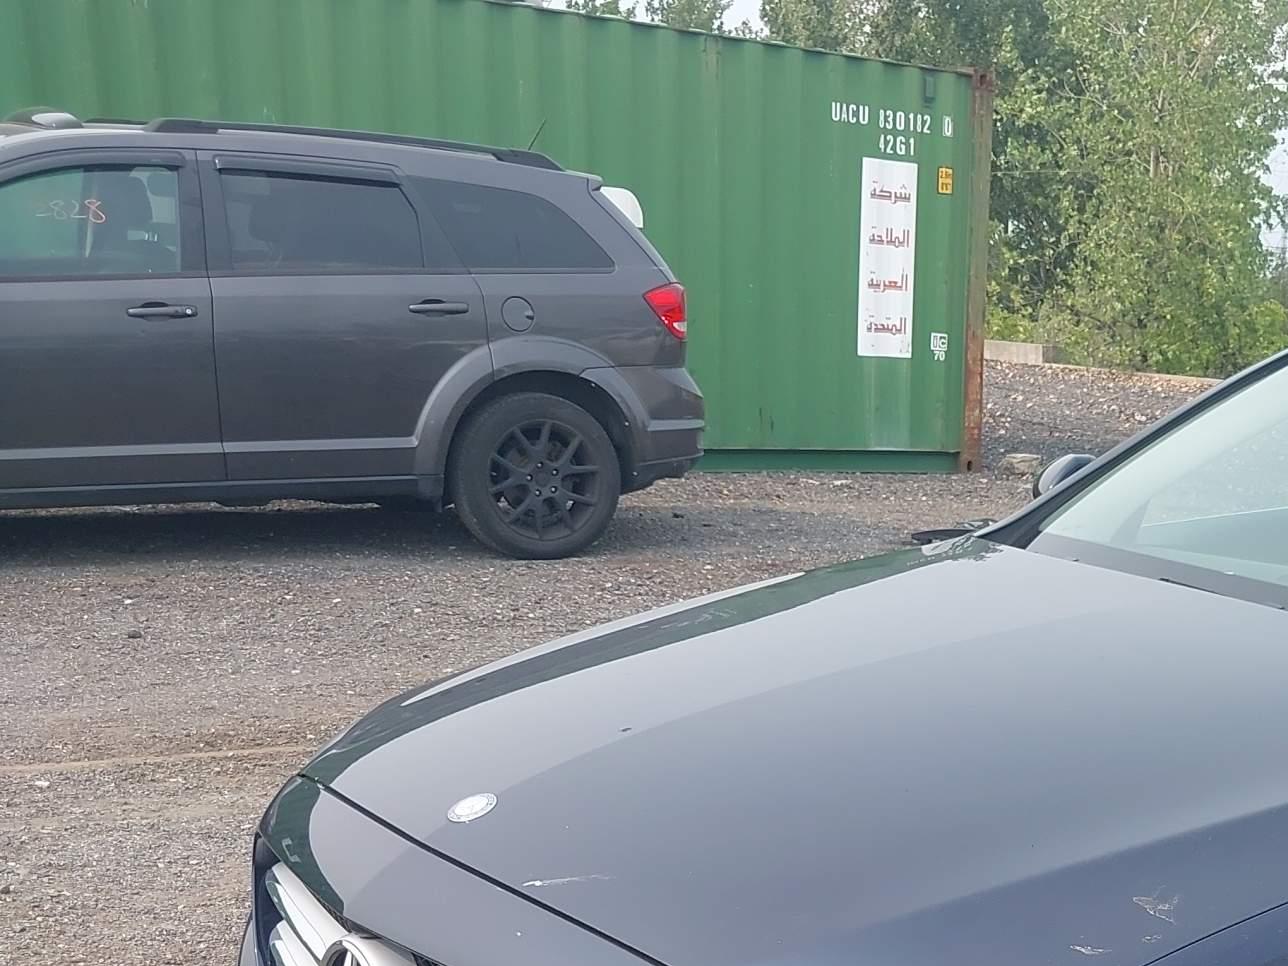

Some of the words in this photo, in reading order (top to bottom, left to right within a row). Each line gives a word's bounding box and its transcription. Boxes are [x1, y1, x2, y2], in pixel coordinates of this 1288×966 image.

[831, 101, 869, 124] UACU
[879, 109, 931, 134] 830182
[879, 134, 915, 156] 42G1
[869, 180, 911, 205] شركة
[868, 225, 910, 249] الملاحة
[865, 314, 907, 336] المتحدة
[933, 350, 946, 361] 70
